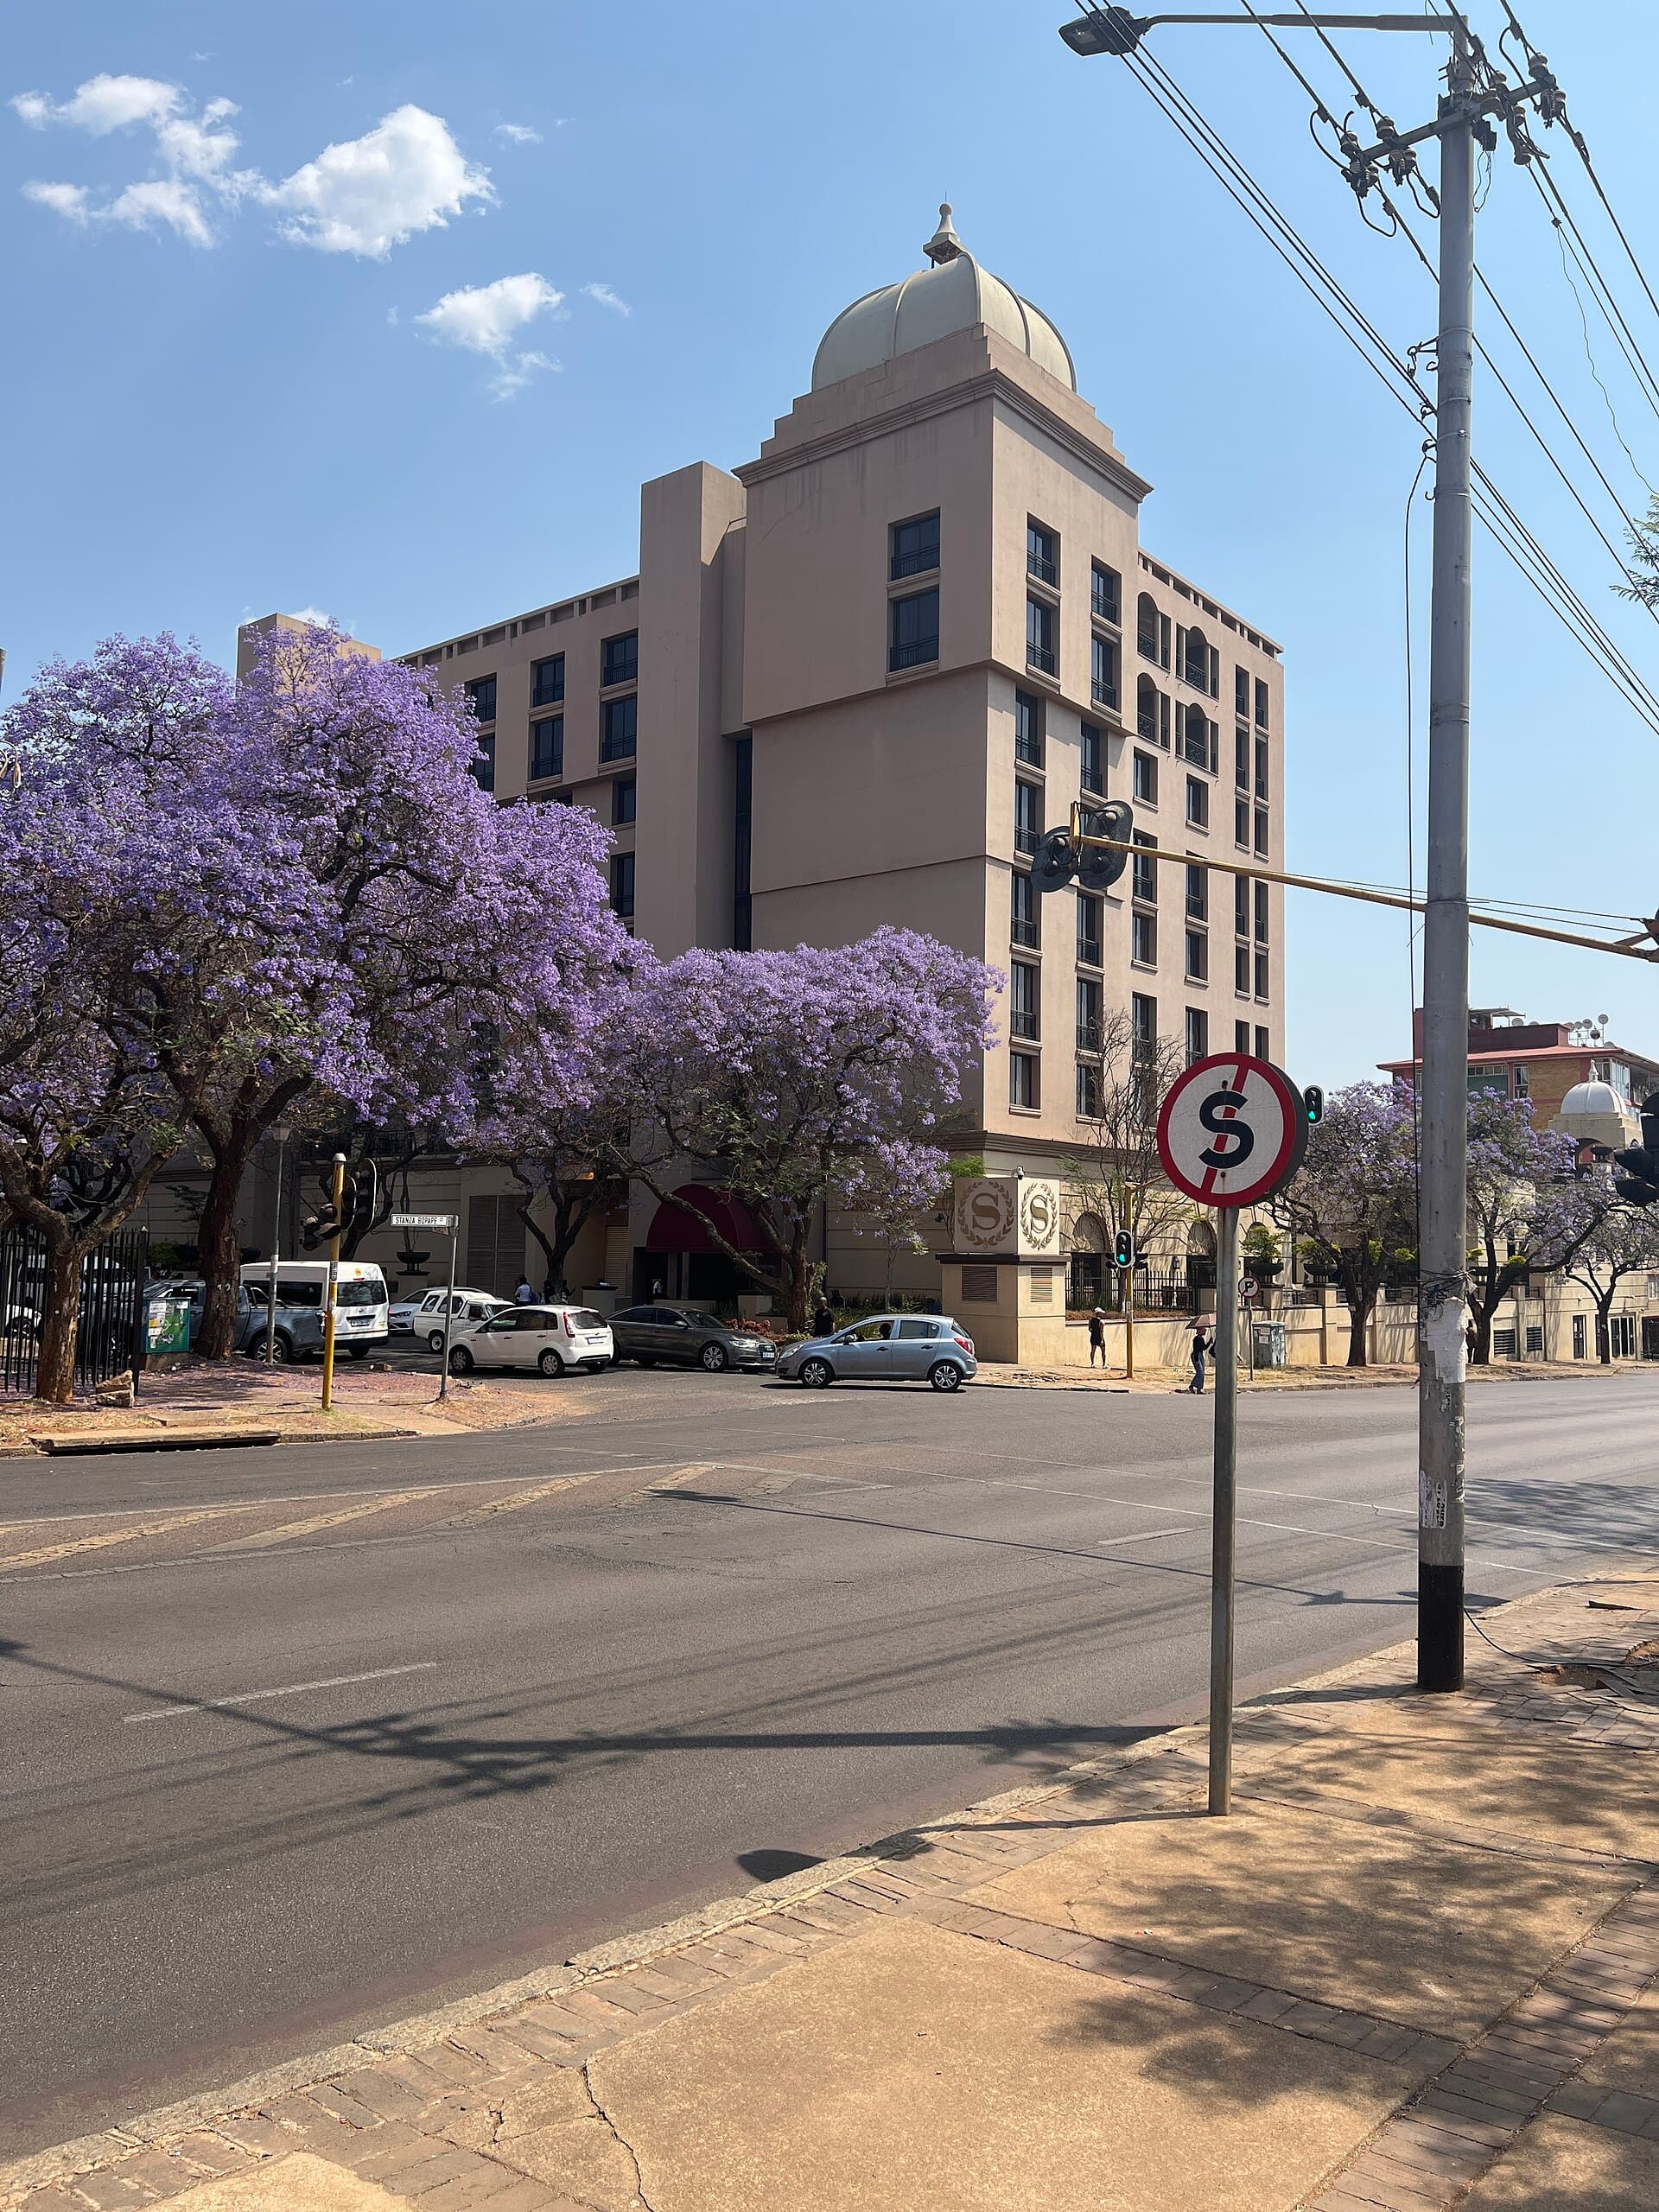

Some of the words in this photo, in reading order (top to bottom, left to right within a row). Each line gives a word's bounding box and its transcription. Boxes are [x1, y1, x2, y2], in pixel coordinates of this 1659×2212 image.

[1198, 1090, 1255, 1169] S
[972, 1193, 1000, 1230] S
[1030, 1195, 1049, 1233] S
[1244, 1281, 1255, 1293] P
